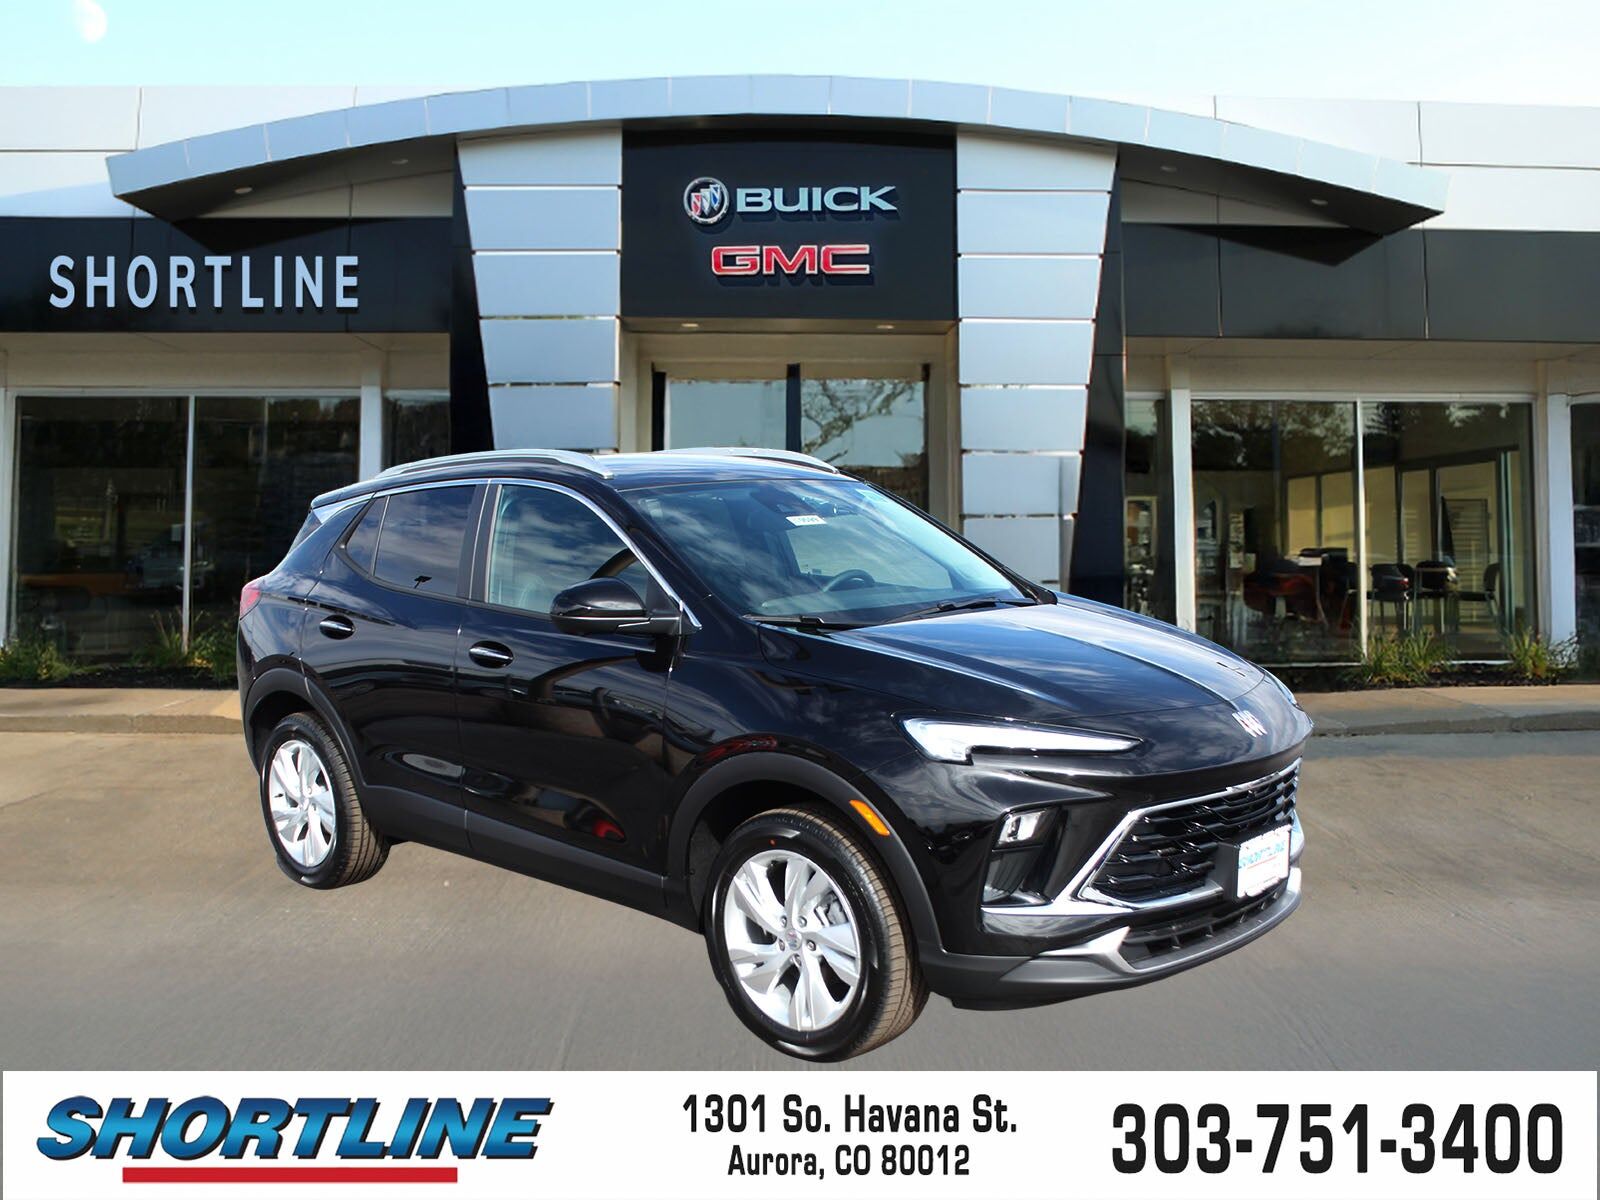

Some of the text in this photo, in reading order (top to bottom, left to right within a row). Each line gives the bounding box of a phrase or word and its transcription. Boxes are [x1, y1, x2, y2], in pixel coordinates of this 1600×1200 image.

[736, 186, 898, 213] BUICK
[711, 244, 870, 276] GMC
[49, 254, 360, 310] SHORTLINE
